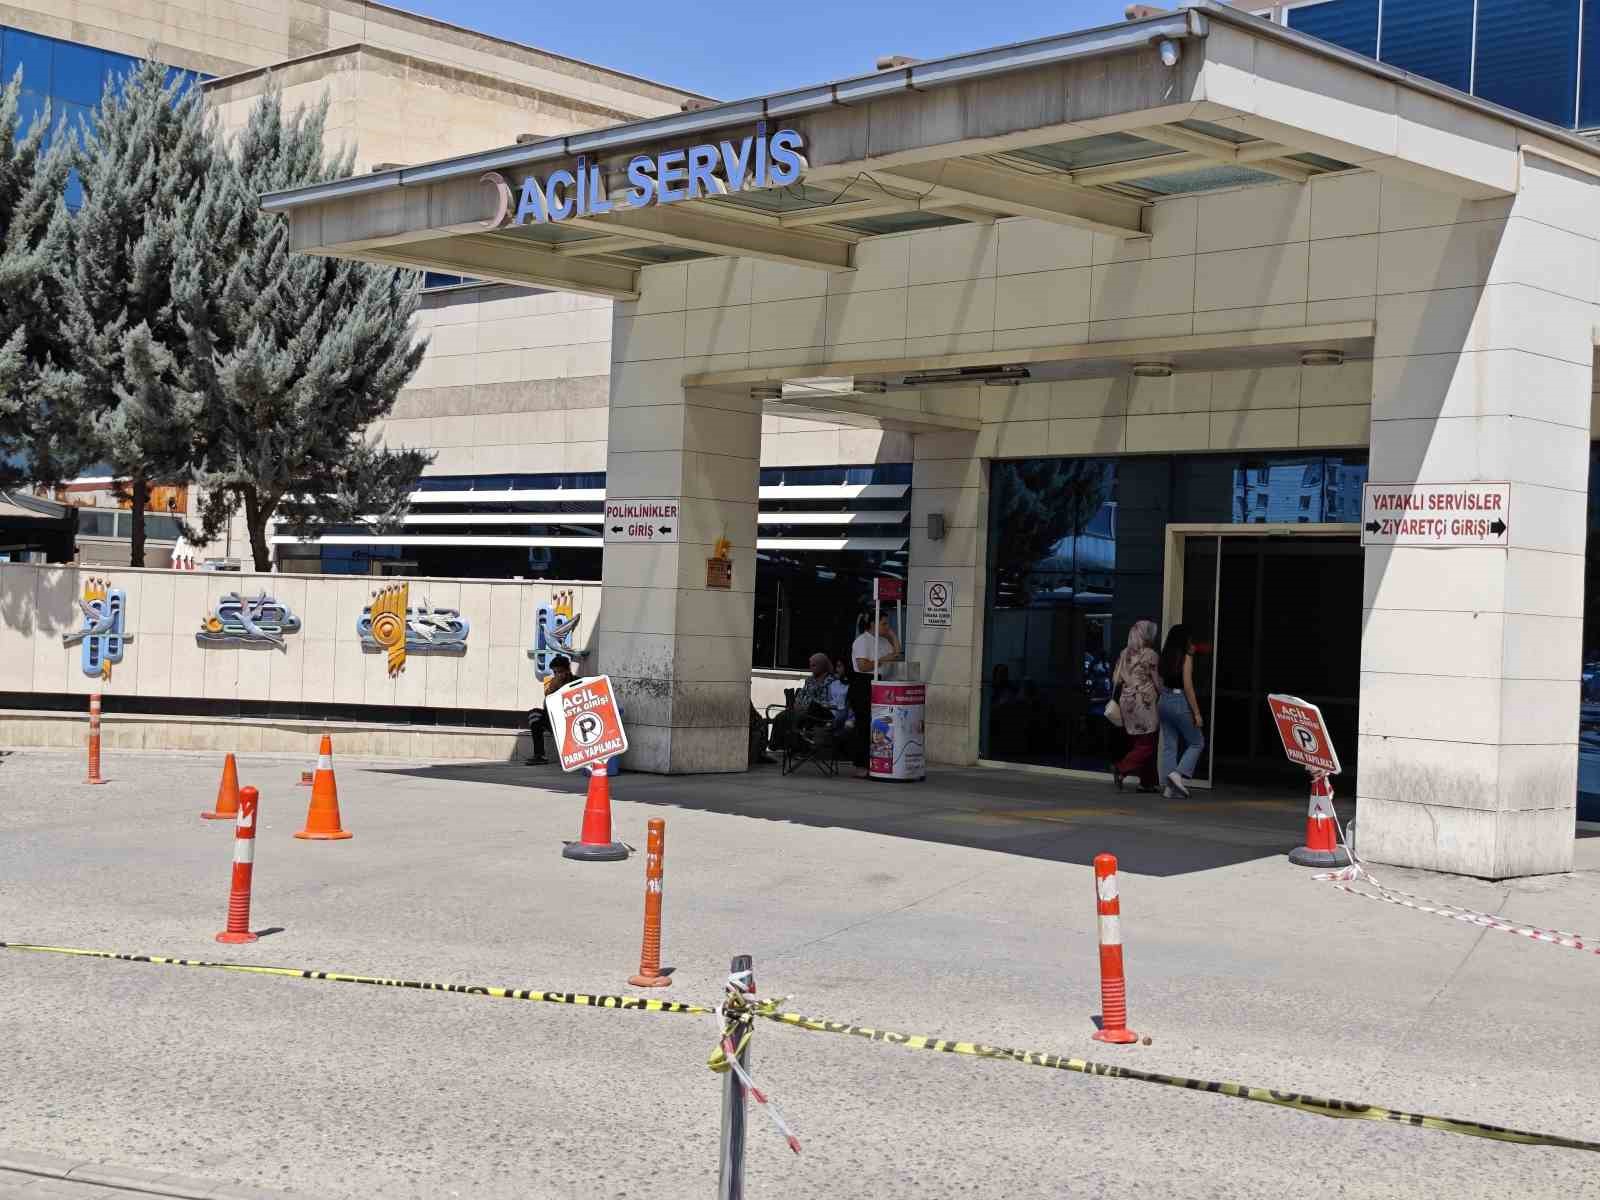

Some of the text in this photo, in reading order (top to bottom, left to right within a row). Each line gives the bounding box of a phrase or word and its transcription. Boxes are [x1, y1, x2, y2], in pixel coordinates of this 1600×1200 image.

[514, 119, 807, 226] ACİL SERVİS
[606, 504, 677, 517] POLİKLİNİKLER
[1373, 490, 1502, 511] YATAKLI SERVİSLER
[628, 522, 654, 540] GİRİŞ
[1380, 518, 1491, 540] ZİYARETÇİ GİRİŞİ
[563, 687, 599, 709] ACİL
[579, 717, 597, 742] P
[1297, 728, 1312, 748] P
[563, 750, 586, 766] PARK
